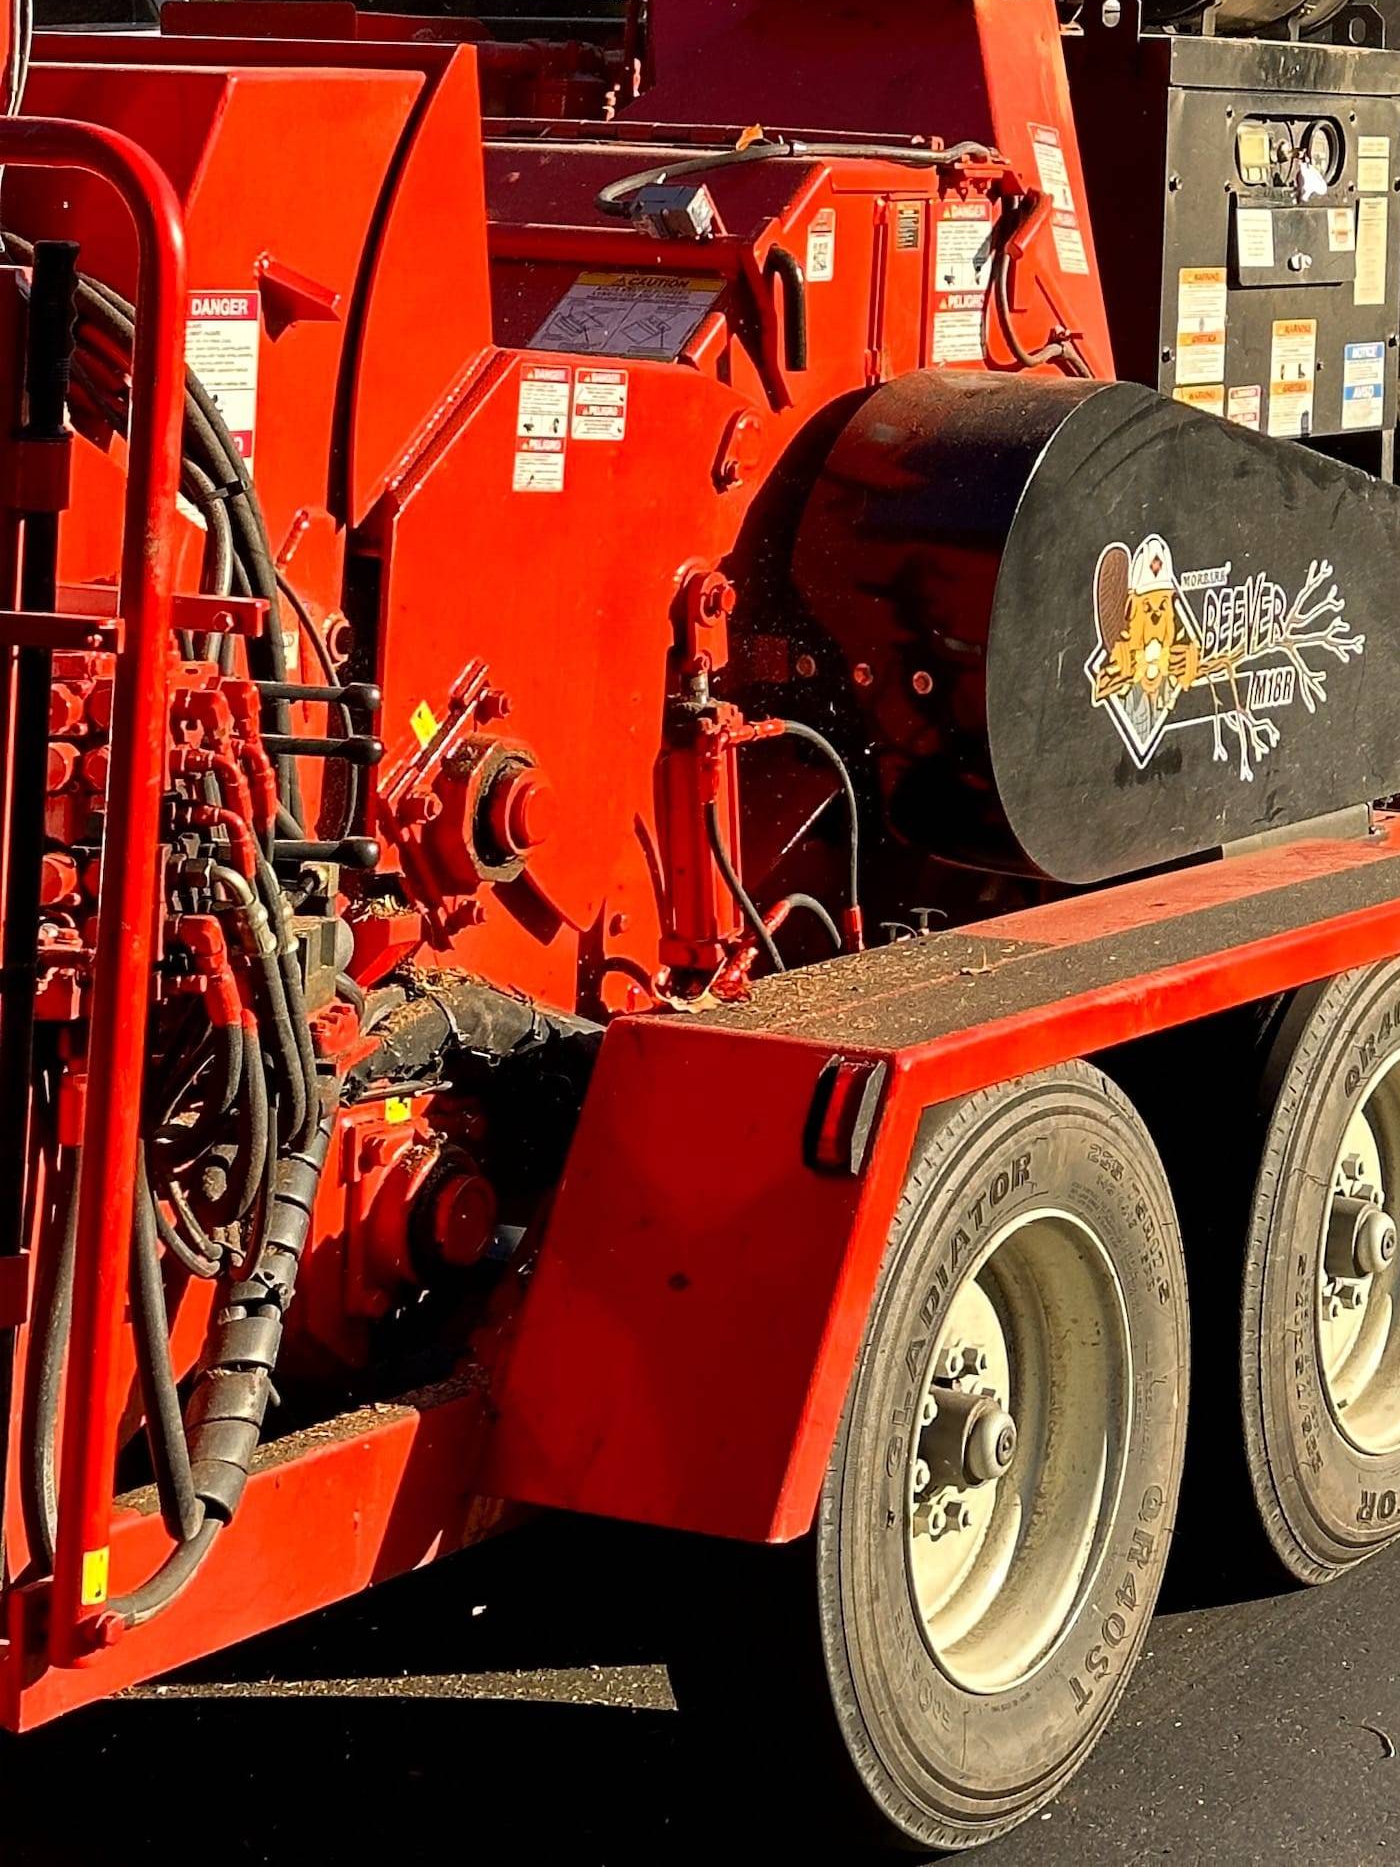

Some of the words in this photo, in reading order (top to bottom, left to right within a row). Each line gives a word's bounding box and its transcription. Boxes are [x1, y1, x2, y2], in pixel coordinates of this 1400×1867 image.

[190, 298, 249, 315] DANGER
[628, 276, 690, 288] CAUTION
[1201, 573, 1287, 662] BEEVER
[885, 1151, 1032, 1479] GLADIATOR
[1068, 1484, 1163, 1716] QR40ST
